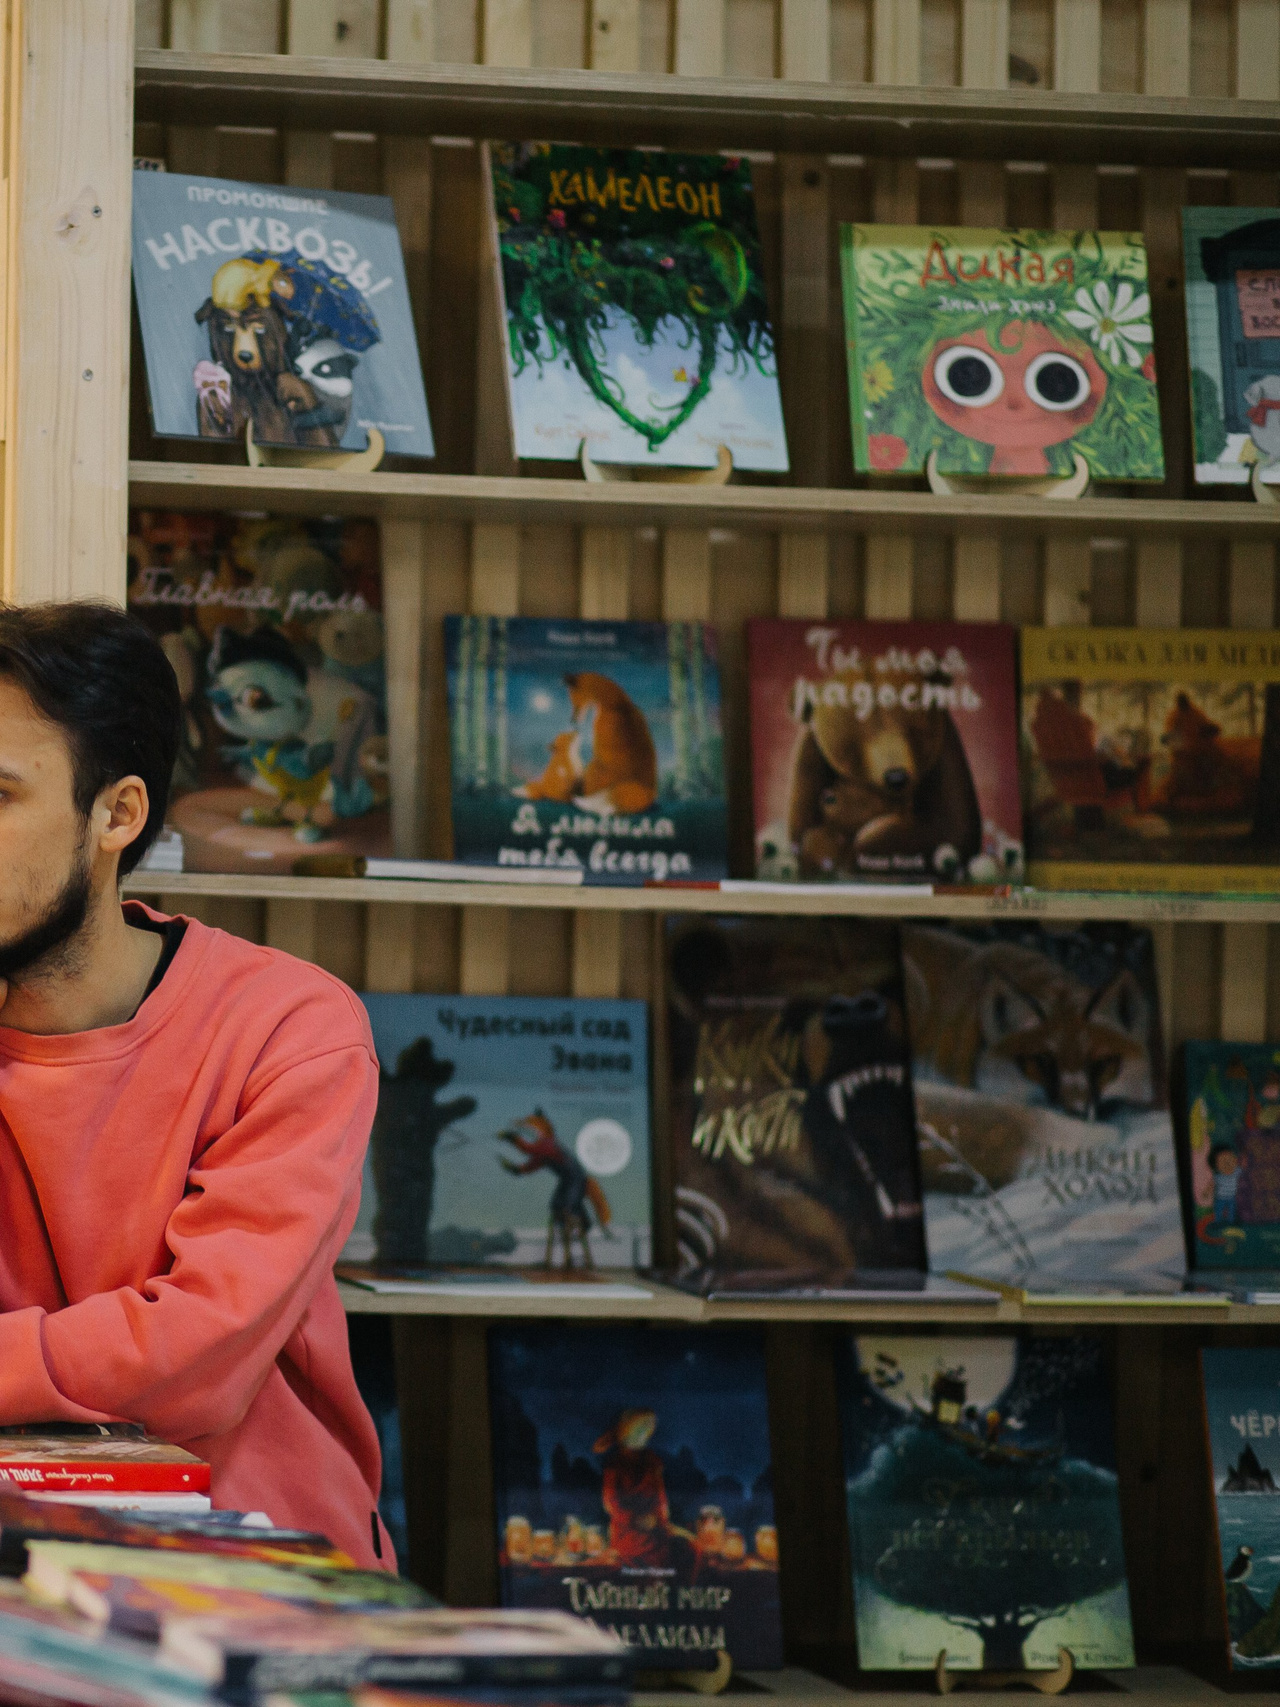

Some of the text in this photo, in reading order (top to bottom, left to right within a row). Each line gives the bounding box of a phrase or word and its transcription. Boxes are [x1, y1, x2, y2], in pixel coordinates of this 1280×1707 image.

[548, 167, 721, 218] ХАМЕЛЕОН
[921, 240, 1074, 289] Дикая
[791, 676, 981, 722] радость
[437, 1008, 631, 1042] Чудесный сад
[9, 1468, 45, 1483] ЗАЯЦ
